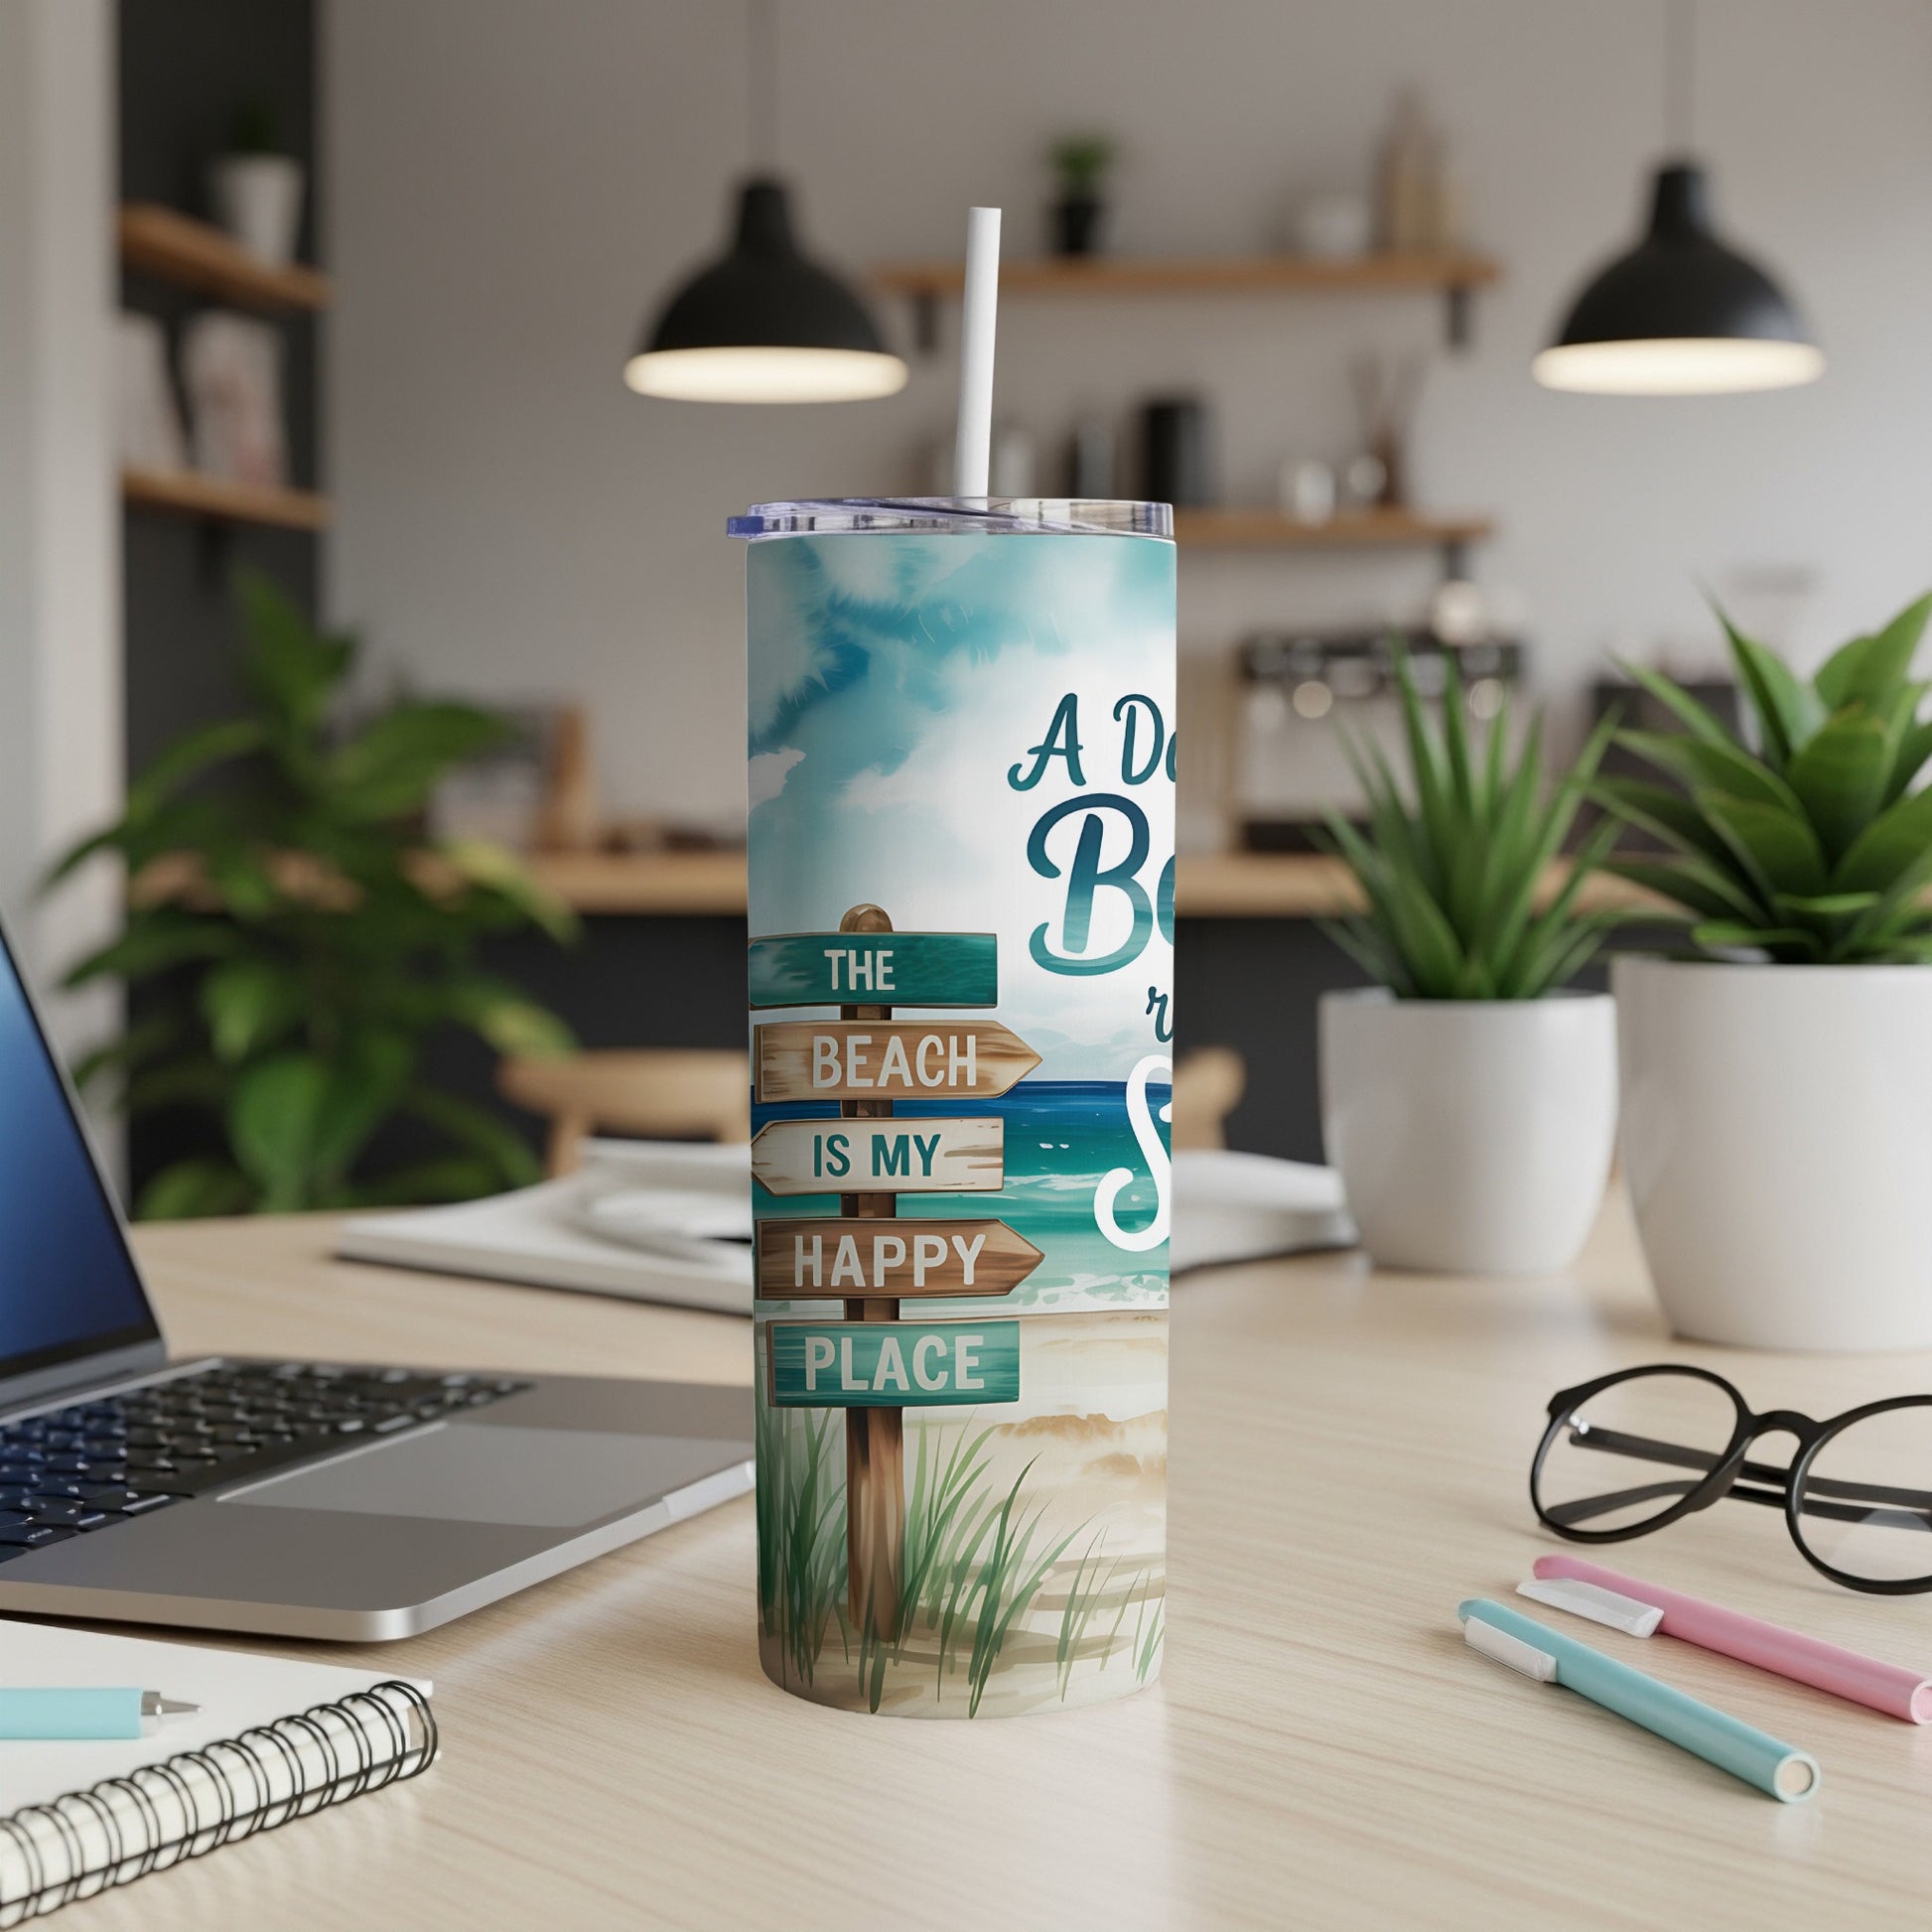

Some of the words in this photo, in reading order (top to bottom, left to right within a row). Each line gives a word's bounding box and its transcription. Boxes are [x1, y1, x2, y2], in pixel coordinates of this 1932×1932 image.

[1007, 692, 1087, 792] A
[1112, 693, 1177, 786] D
[823, 949, 897, 992] THE
[812, 1035, 978, 1089] BEACH
[813, 1133, 852, 1178] IS
[871, 1133, 942, 1177] MY
[794, 1233, 987, 1289] HAPPY
[804, 1334, 986, 1392] PLACE
